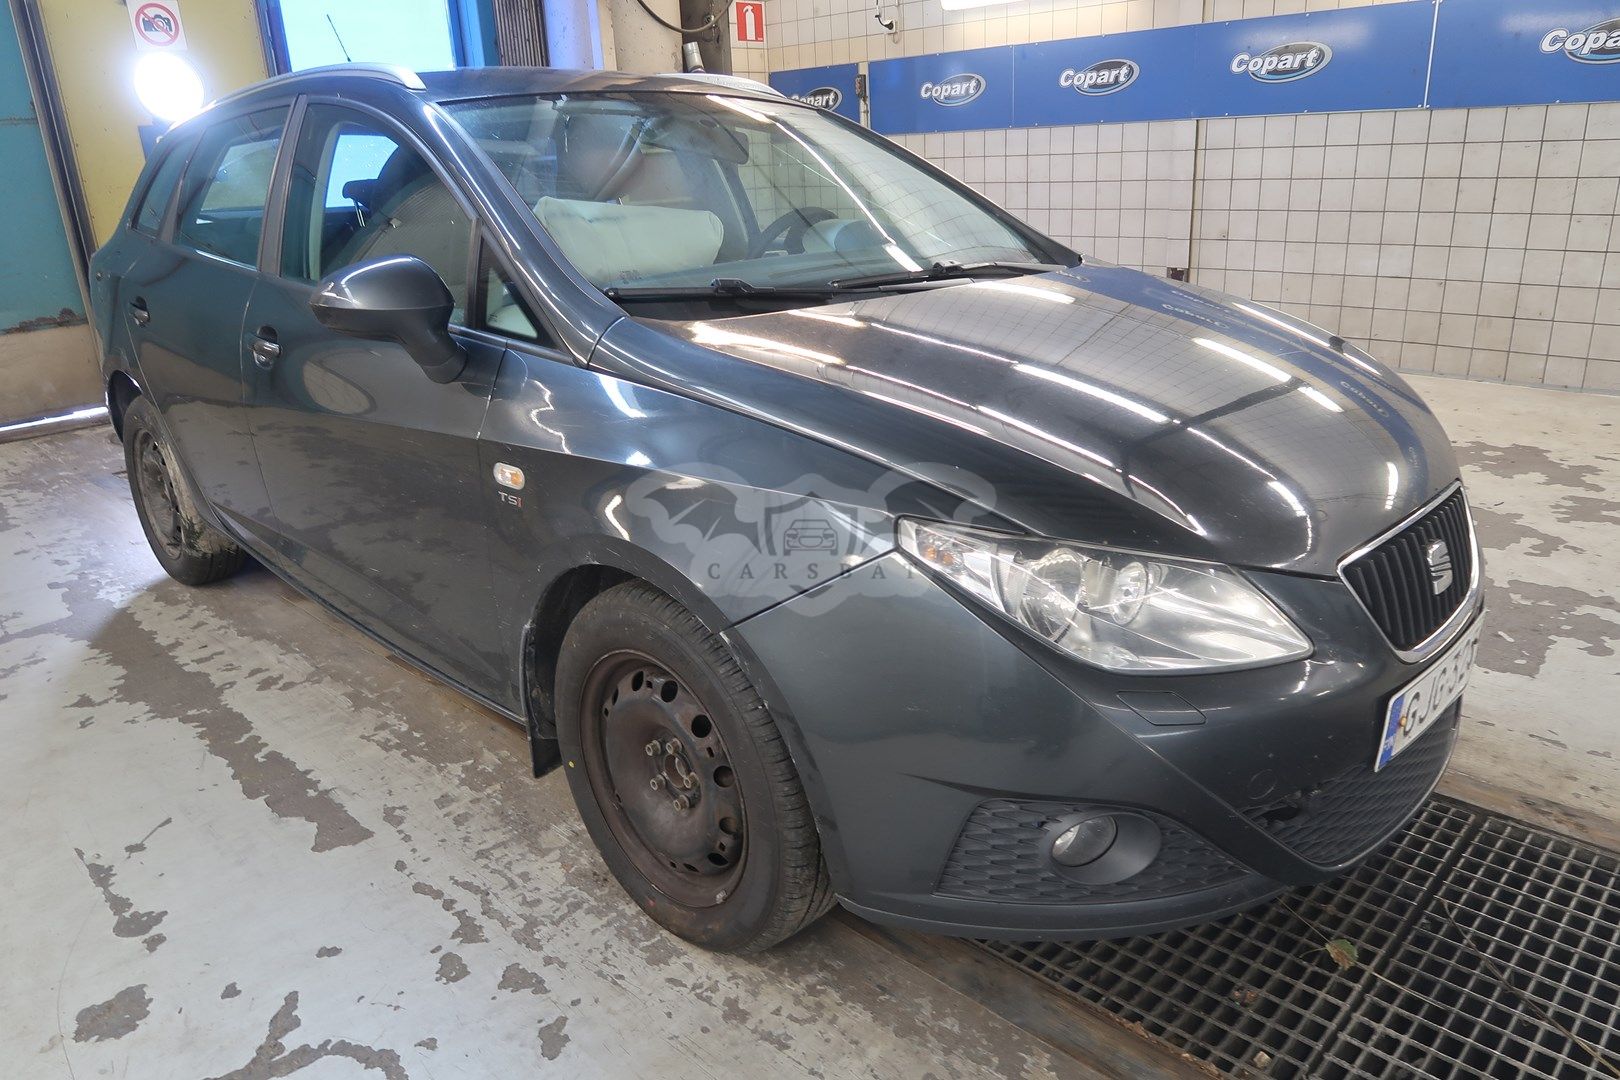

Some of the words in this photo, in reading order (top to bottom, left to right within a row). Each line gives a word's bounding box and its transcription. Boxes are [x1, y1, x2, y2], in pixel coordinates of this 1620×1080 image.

[1230, 47, 1319, 75] Copart
[920, 78, 979, 100] Copart
[1059, 64, 1131, 90] Copart
